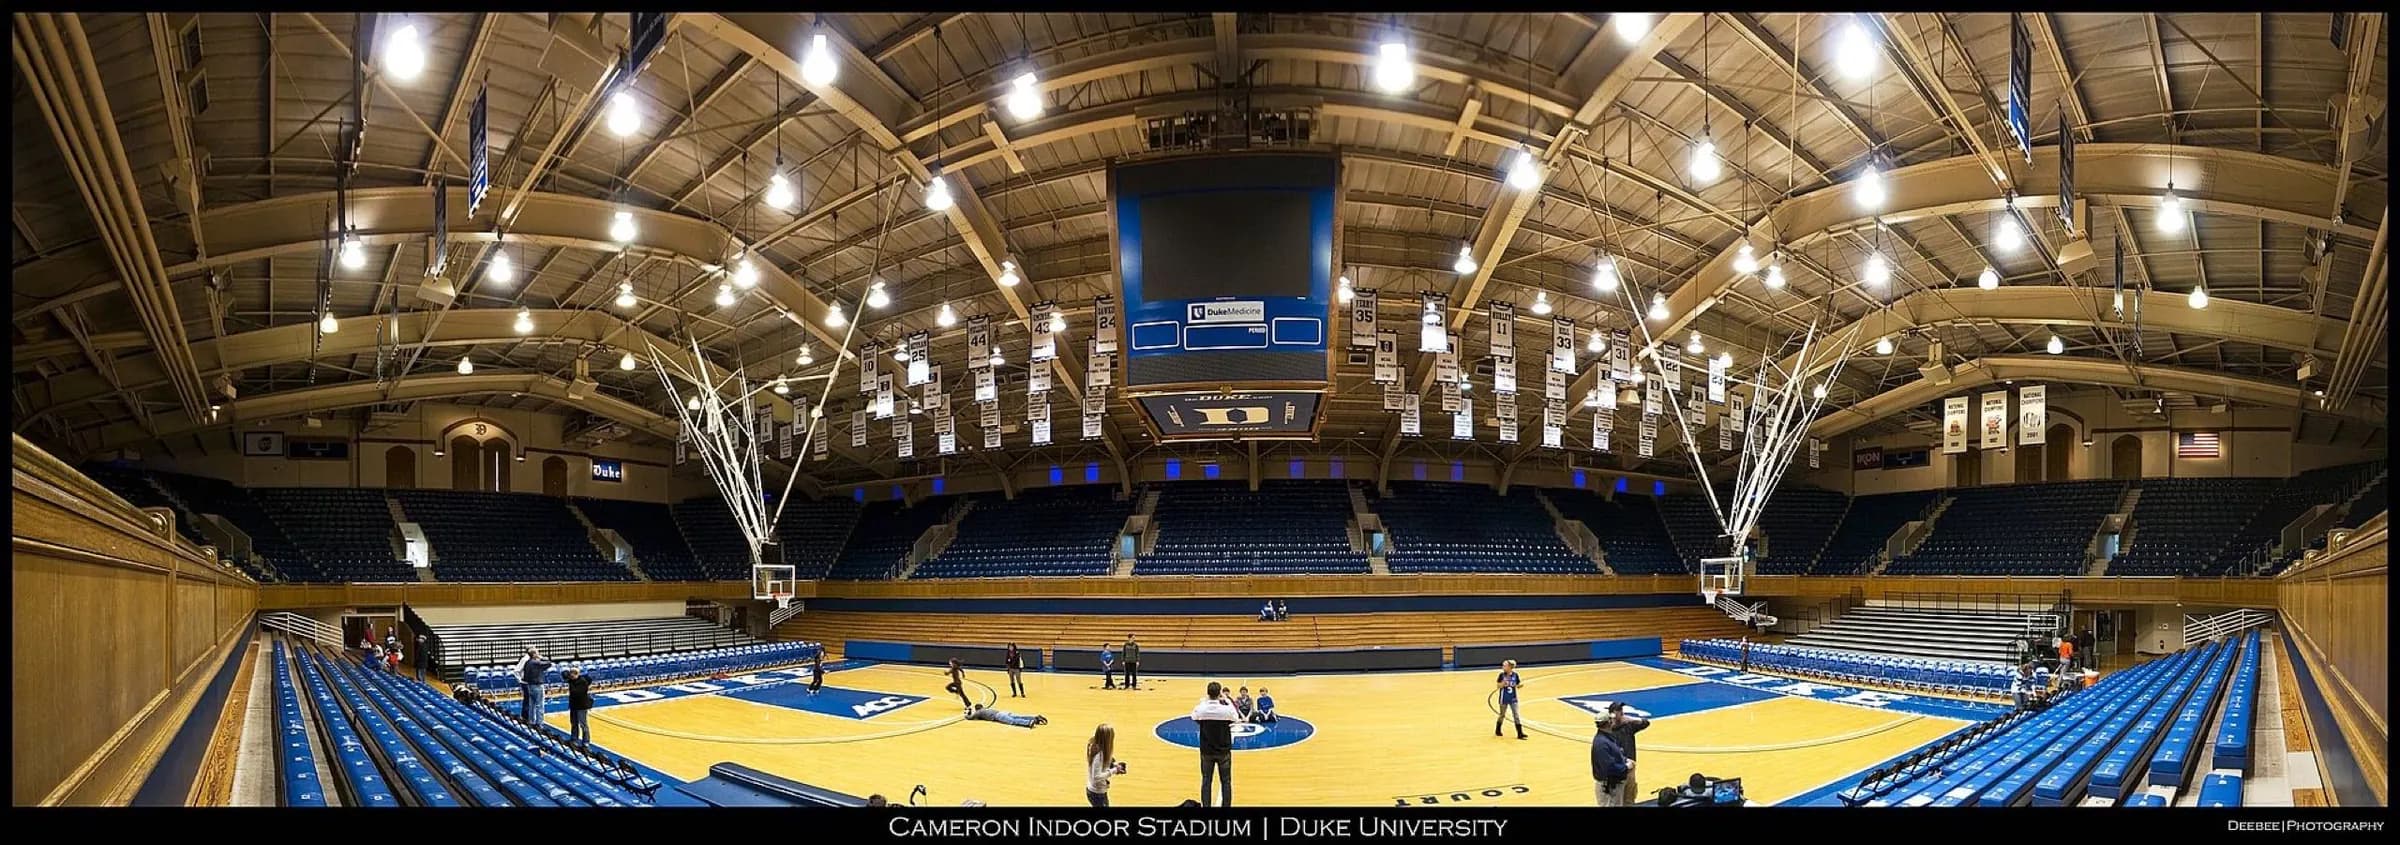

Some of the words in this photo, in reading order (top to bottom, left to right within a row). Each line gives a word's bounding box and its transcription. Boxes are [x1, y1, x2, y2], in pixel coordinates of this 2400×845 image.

[1355, 309, 1374, 323] 35
[1034, 322, 1050, 336] 43
[1496, 322, 1507, 335] 11
[970, 334, 987, 347] 44
[1556, 336, 1572, 350] 33
[911, 349, 926, 363] 25
[1615, 348, 1627, 361] 31
[864, 361, 874, 373] 10
[593, 464, 622, 479] Duke
[851, 696, 913, 717] ACC
[1394, 785, 1530, 807] COURT
